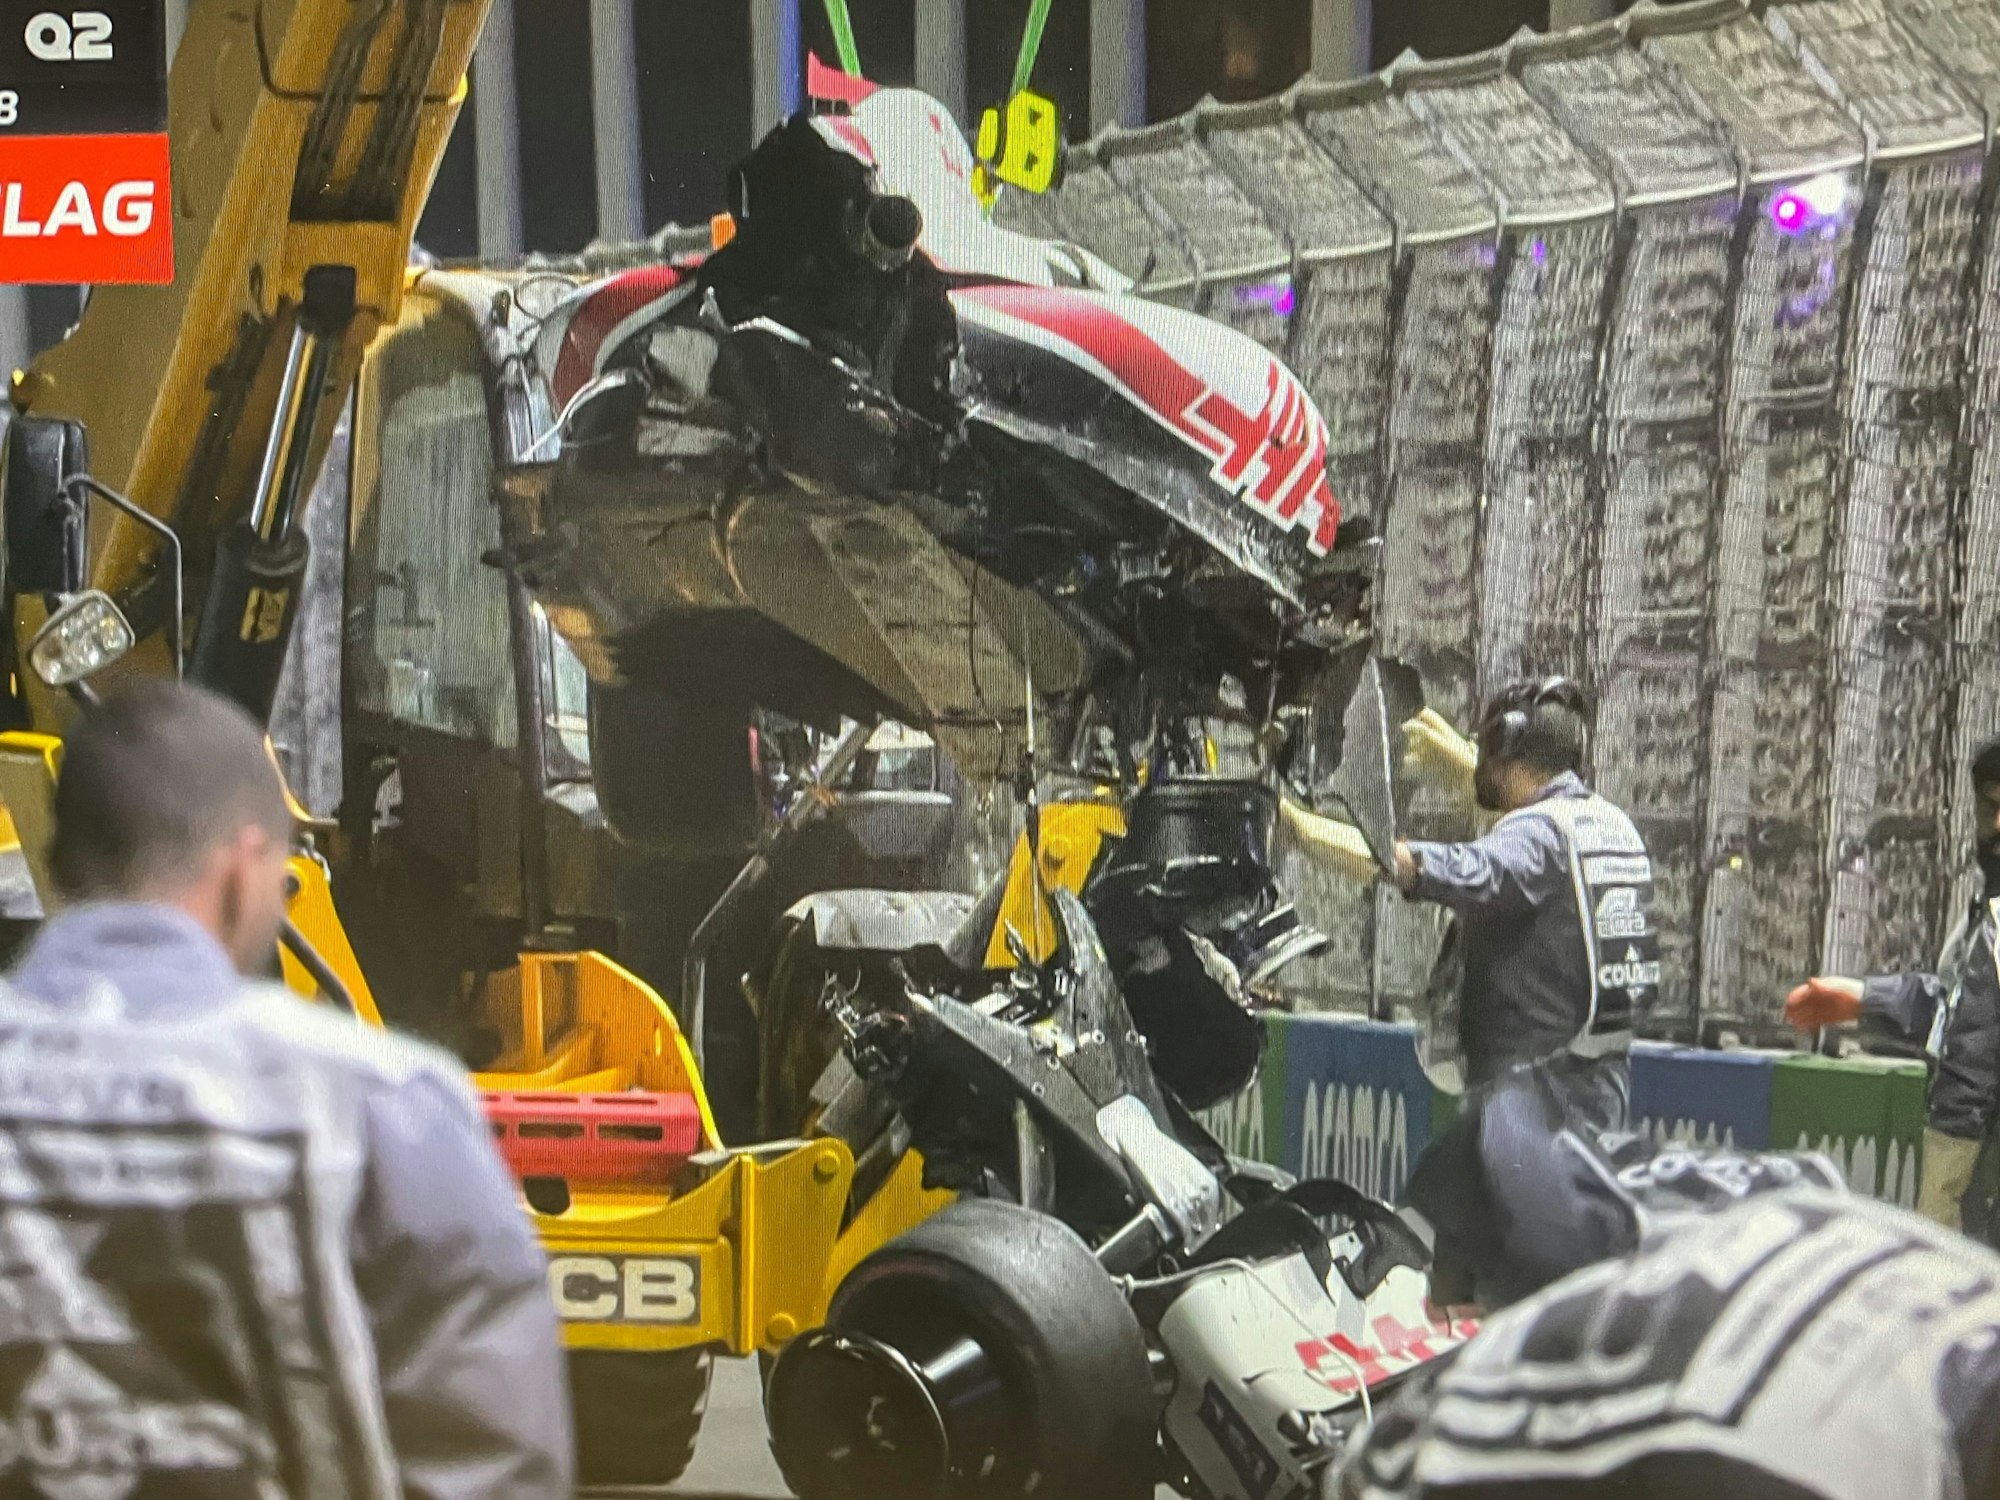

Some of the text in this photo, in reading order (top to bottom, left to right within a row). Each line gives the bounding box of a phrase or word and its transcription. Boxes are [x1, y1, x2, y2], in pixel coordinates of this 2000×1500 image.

[24, 11, 113, 61] Q2
[0, 181, 155, 237] LAG
[547, 1256, 696, 1320] CB
